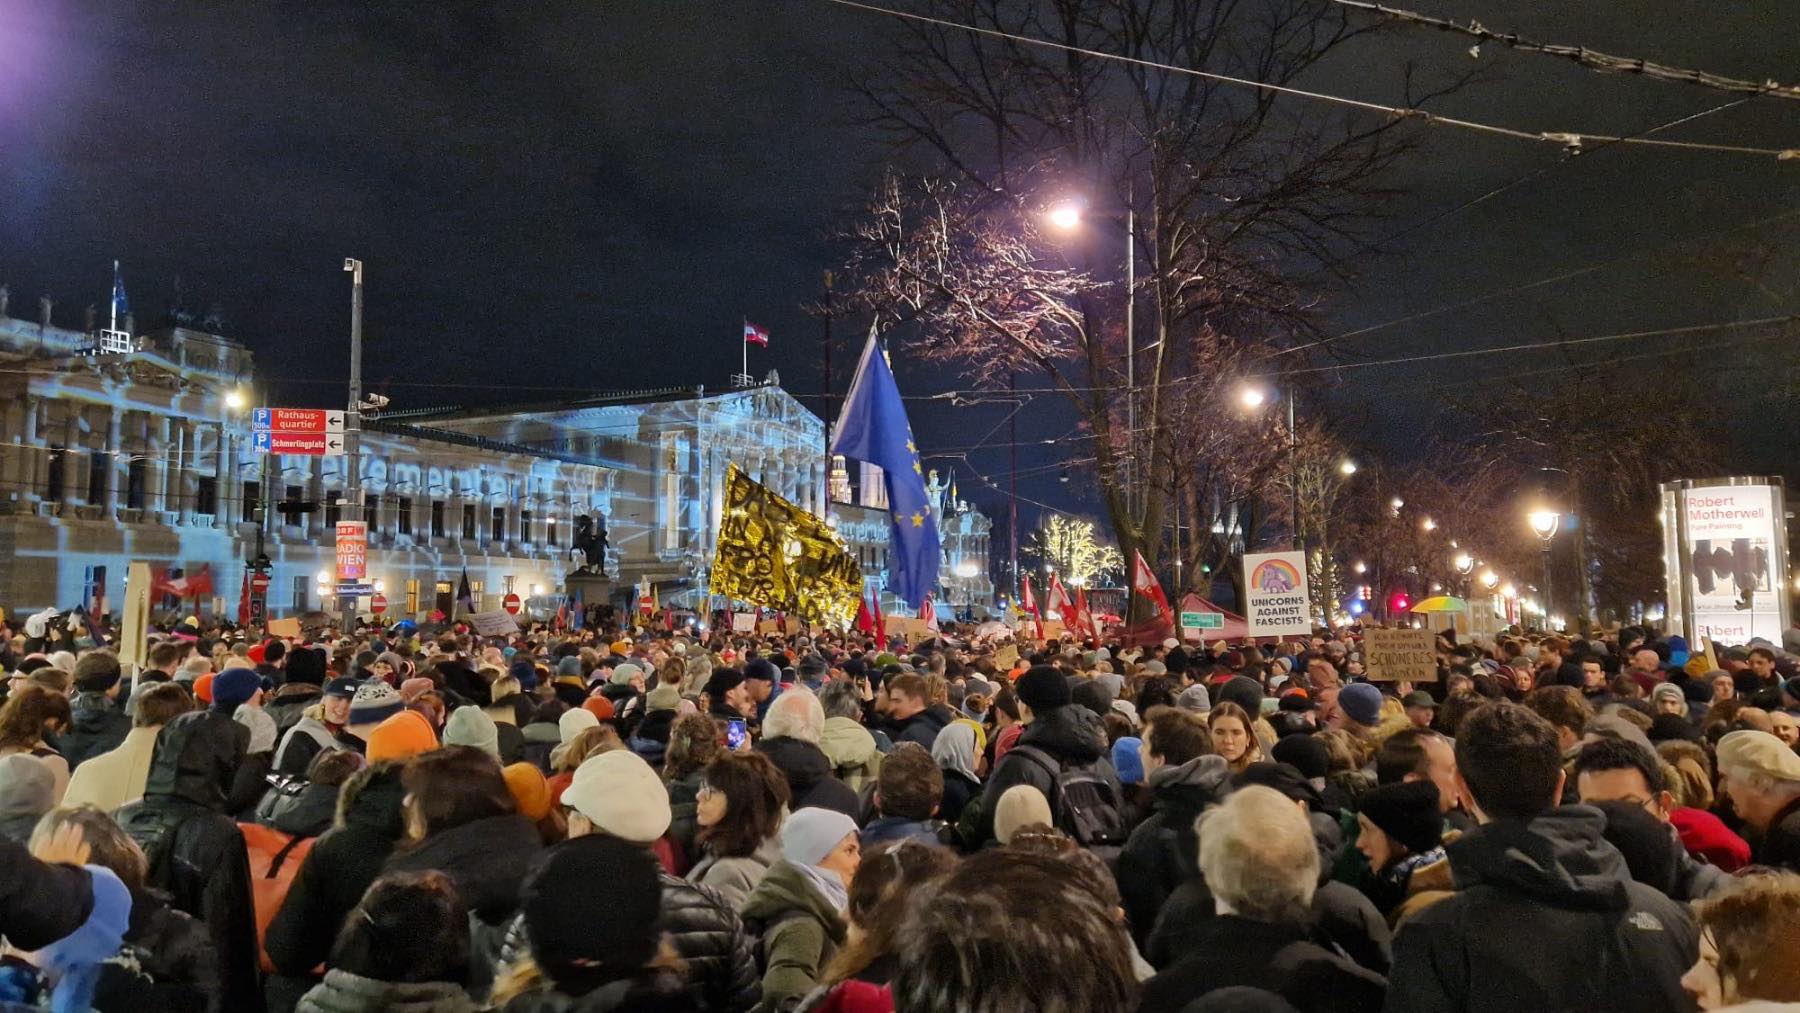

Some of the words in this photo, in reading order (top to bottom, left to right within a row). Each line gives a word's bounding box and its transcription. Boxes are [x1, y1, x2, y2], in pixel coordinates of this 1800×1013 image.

[278, 411, 319, 420] Rathaus-
[280, 421, 317, 429] quartier
[272, 439, 325, 450] Schmerlingplatz
[1689, 497, 1735, 507] Robert
[1690, 508, 1764, 520] Motherwell
[1251, 597, 1304, 607] UNICORNS
[1257, 607, 1300, 616] AGAINST
[1256, 616, 1304, 626] FASCISTS
